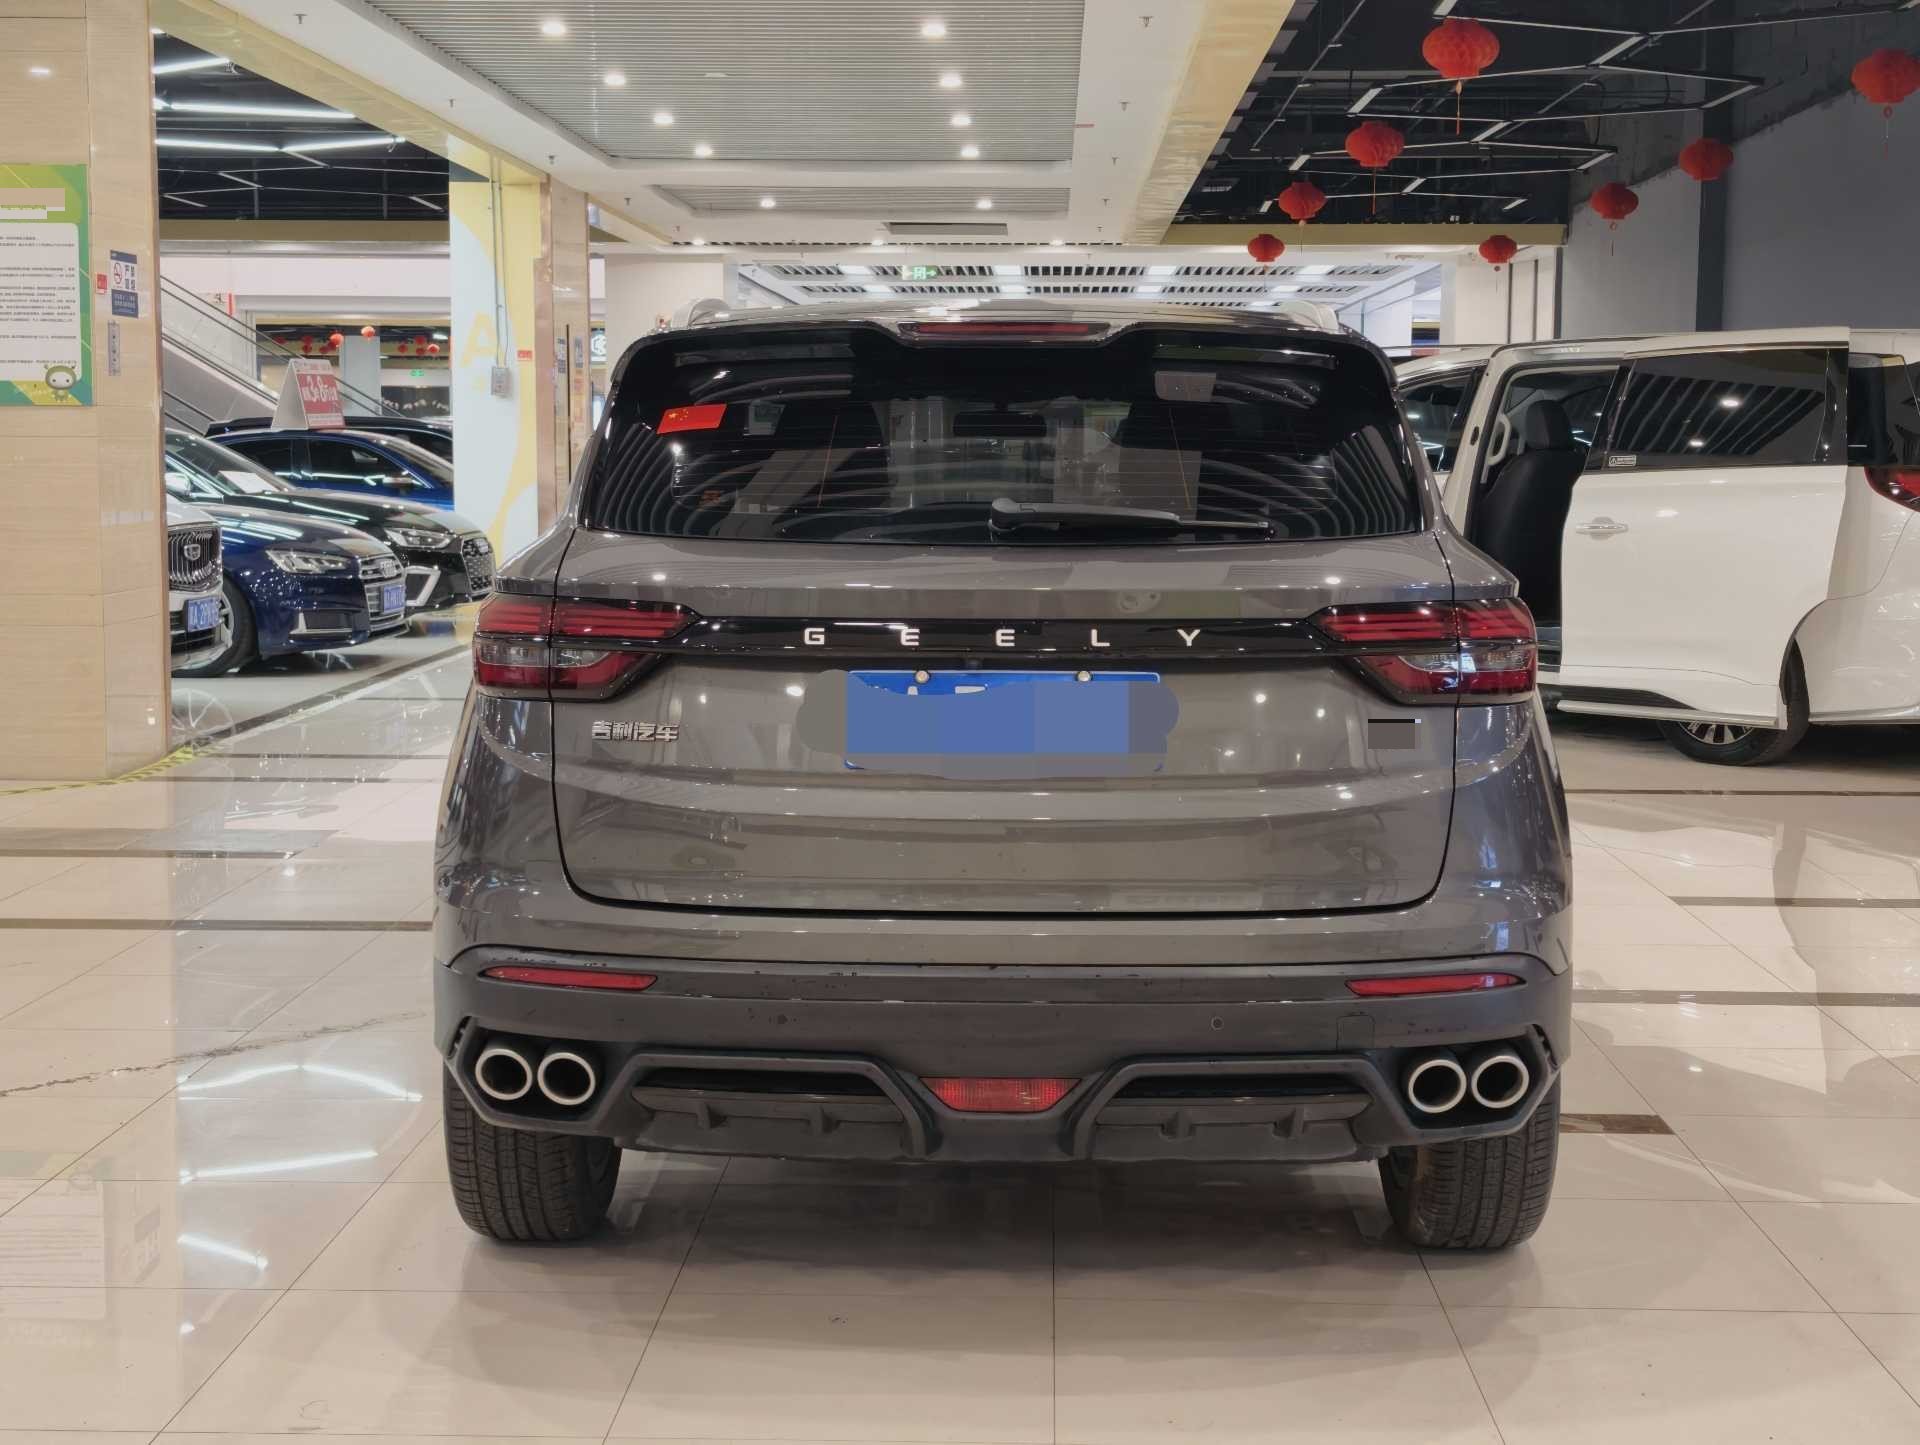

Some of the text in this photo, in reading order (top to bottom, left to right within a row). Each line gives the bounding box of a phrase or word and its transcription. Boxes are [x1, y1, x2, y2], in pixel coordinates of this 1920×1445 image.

[804, 627, 1201, 647] GEELY
[591, 720, 679, 742] 吉利汽车
